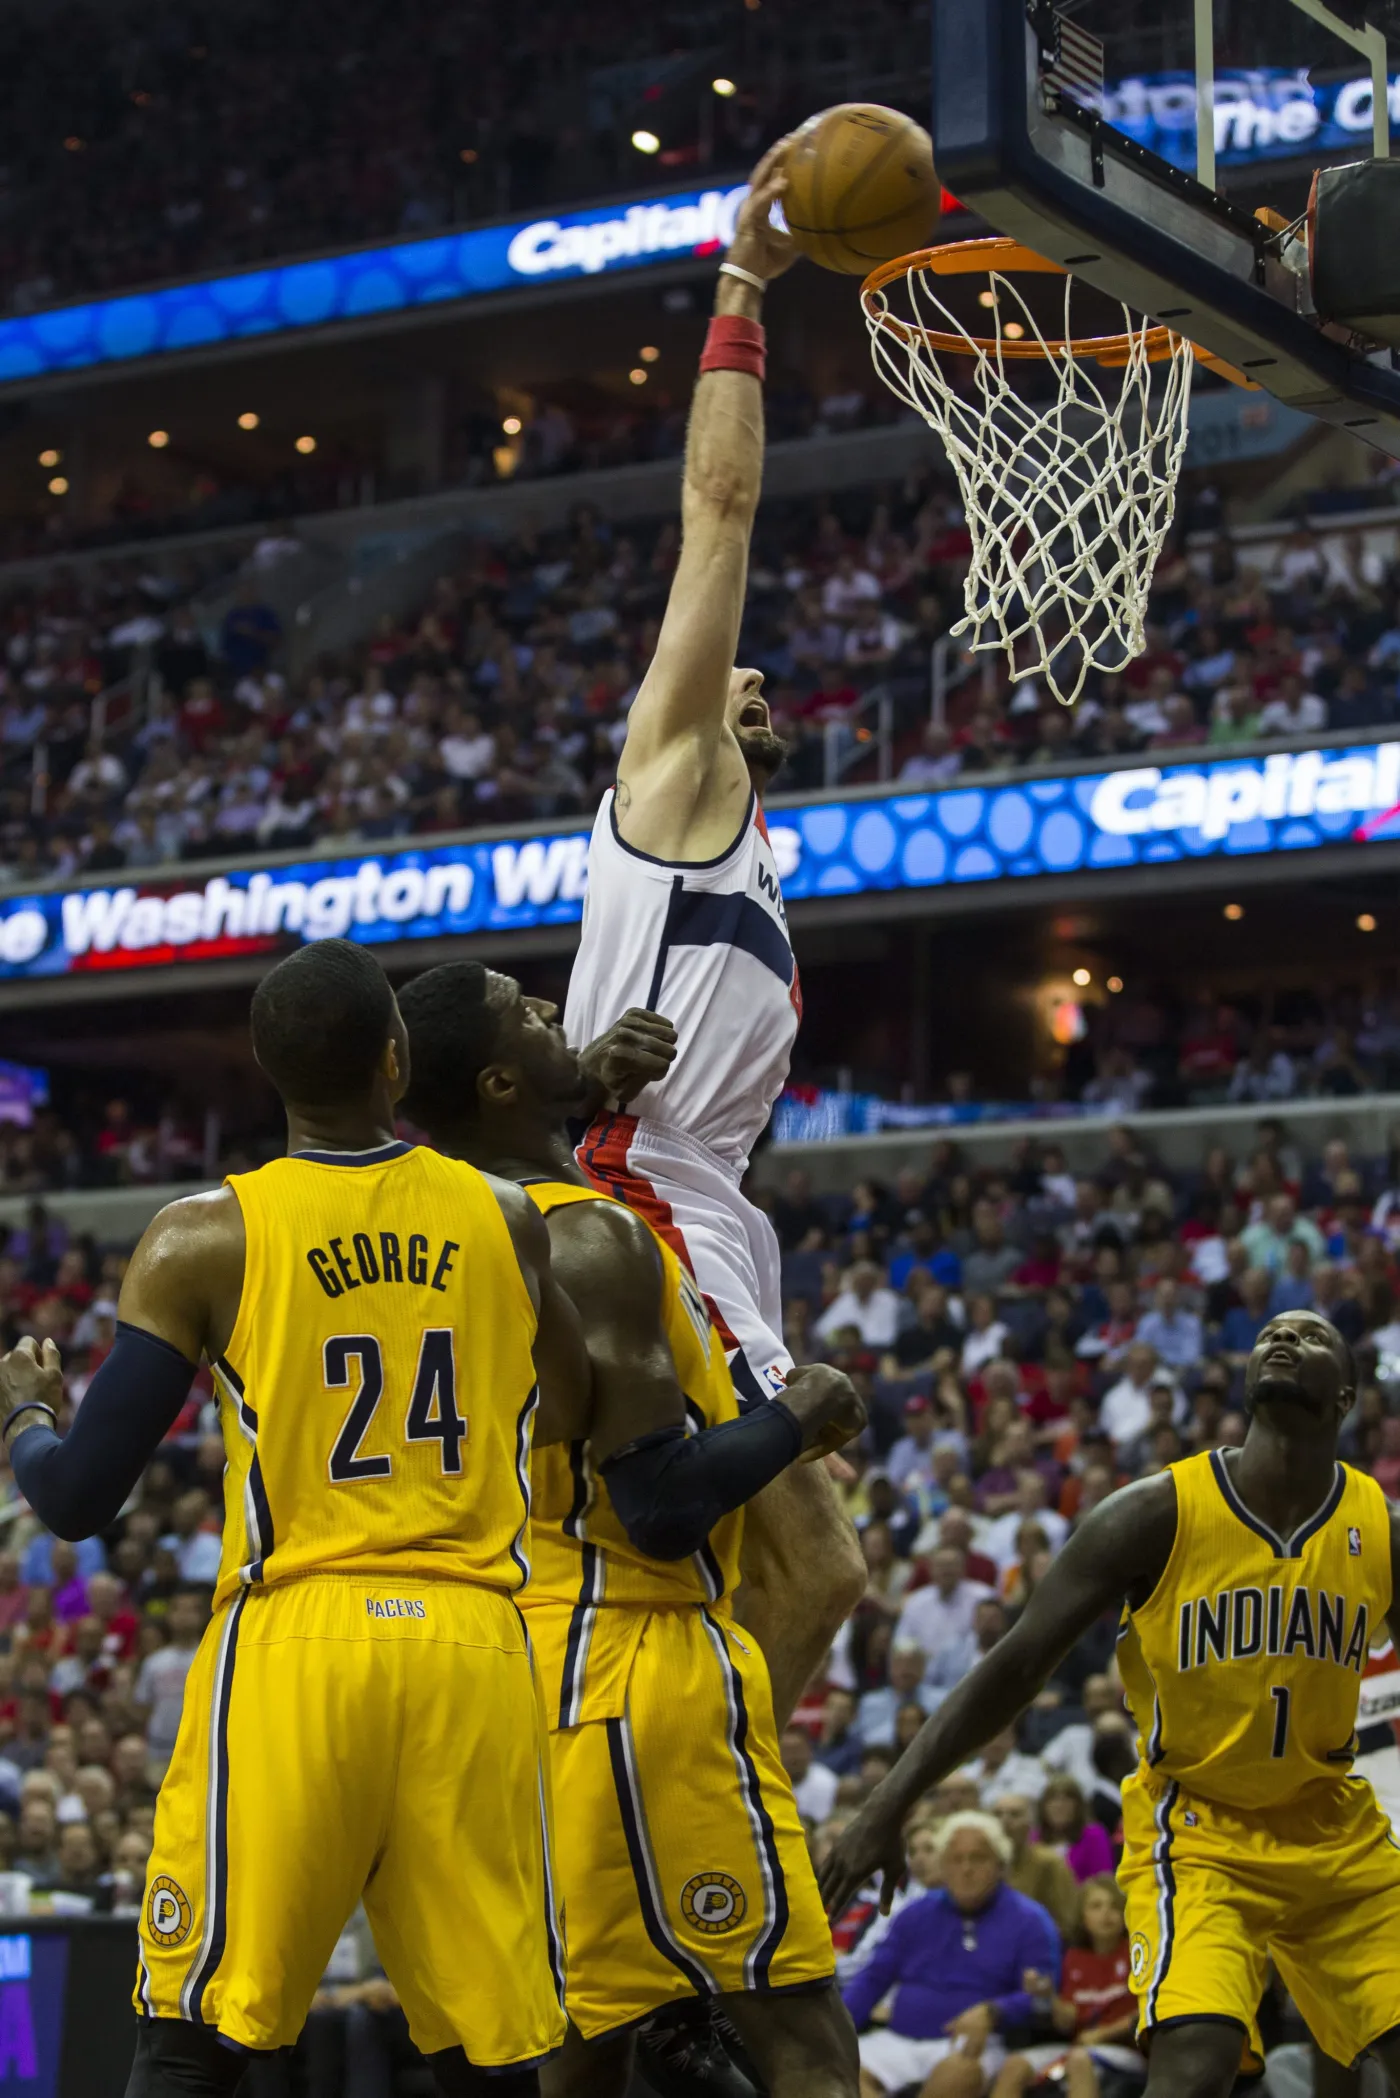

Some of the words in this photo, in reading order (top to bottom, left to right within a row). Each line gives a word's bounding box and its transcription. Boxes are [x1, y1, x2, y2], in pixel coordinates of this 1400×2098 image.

[507, 191, 724, 275] Capital
[1090, 741, 1400, 840] Capital
[61, 860, 475, 954] Washington
[306, 1231, 461, 1299] GEORGE
[322, 1327, 468, 1484] 24
[366, 1597, 427, 1618] PACERS
[1178, 1585, 1369, 1673] INDIANA
[1270, 1685, 1290, 1759] 1
